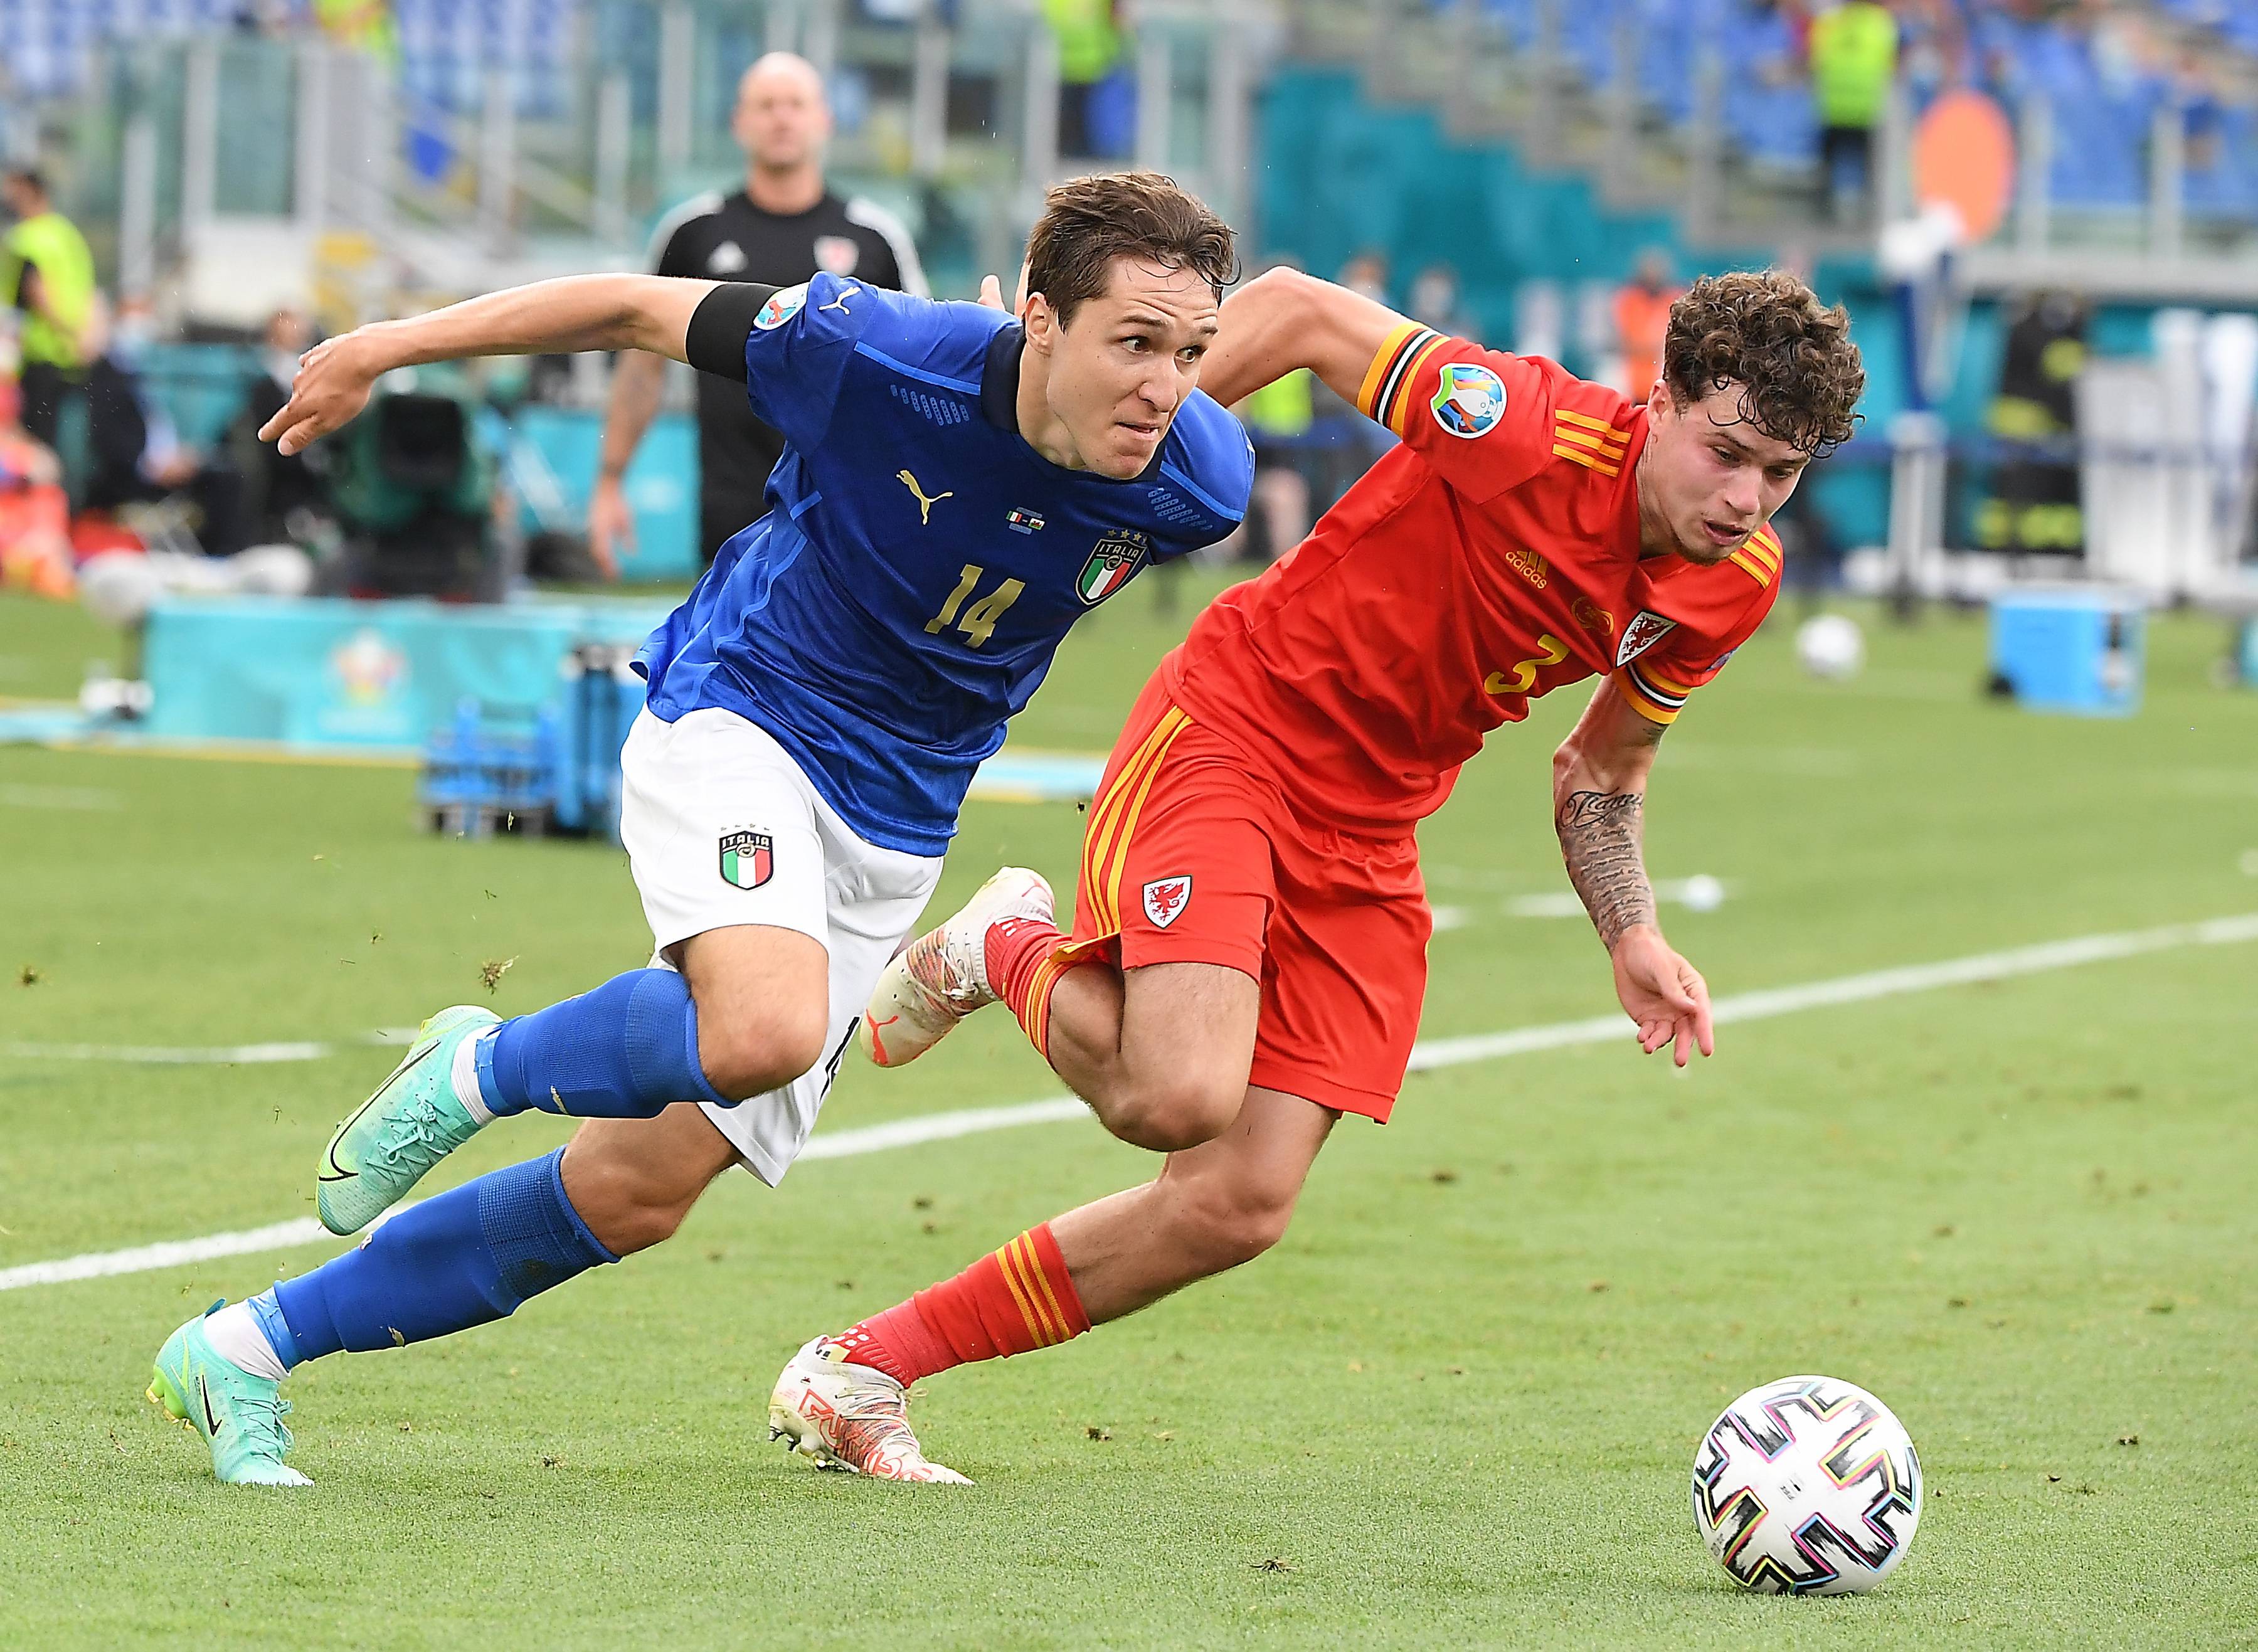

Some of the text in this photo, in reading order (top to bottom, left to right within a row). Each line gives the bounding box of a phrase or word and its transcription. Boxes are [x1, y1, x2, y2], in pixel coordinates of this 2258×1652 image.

[1098, 543, 1140, 559] ITALIA
[1505, 551, 1547, 589] adidas
[924, 563, 1026, 649] 14
[1484, 634, 1571, 694] 3
[722, 834, 770, 849] ITALIA
